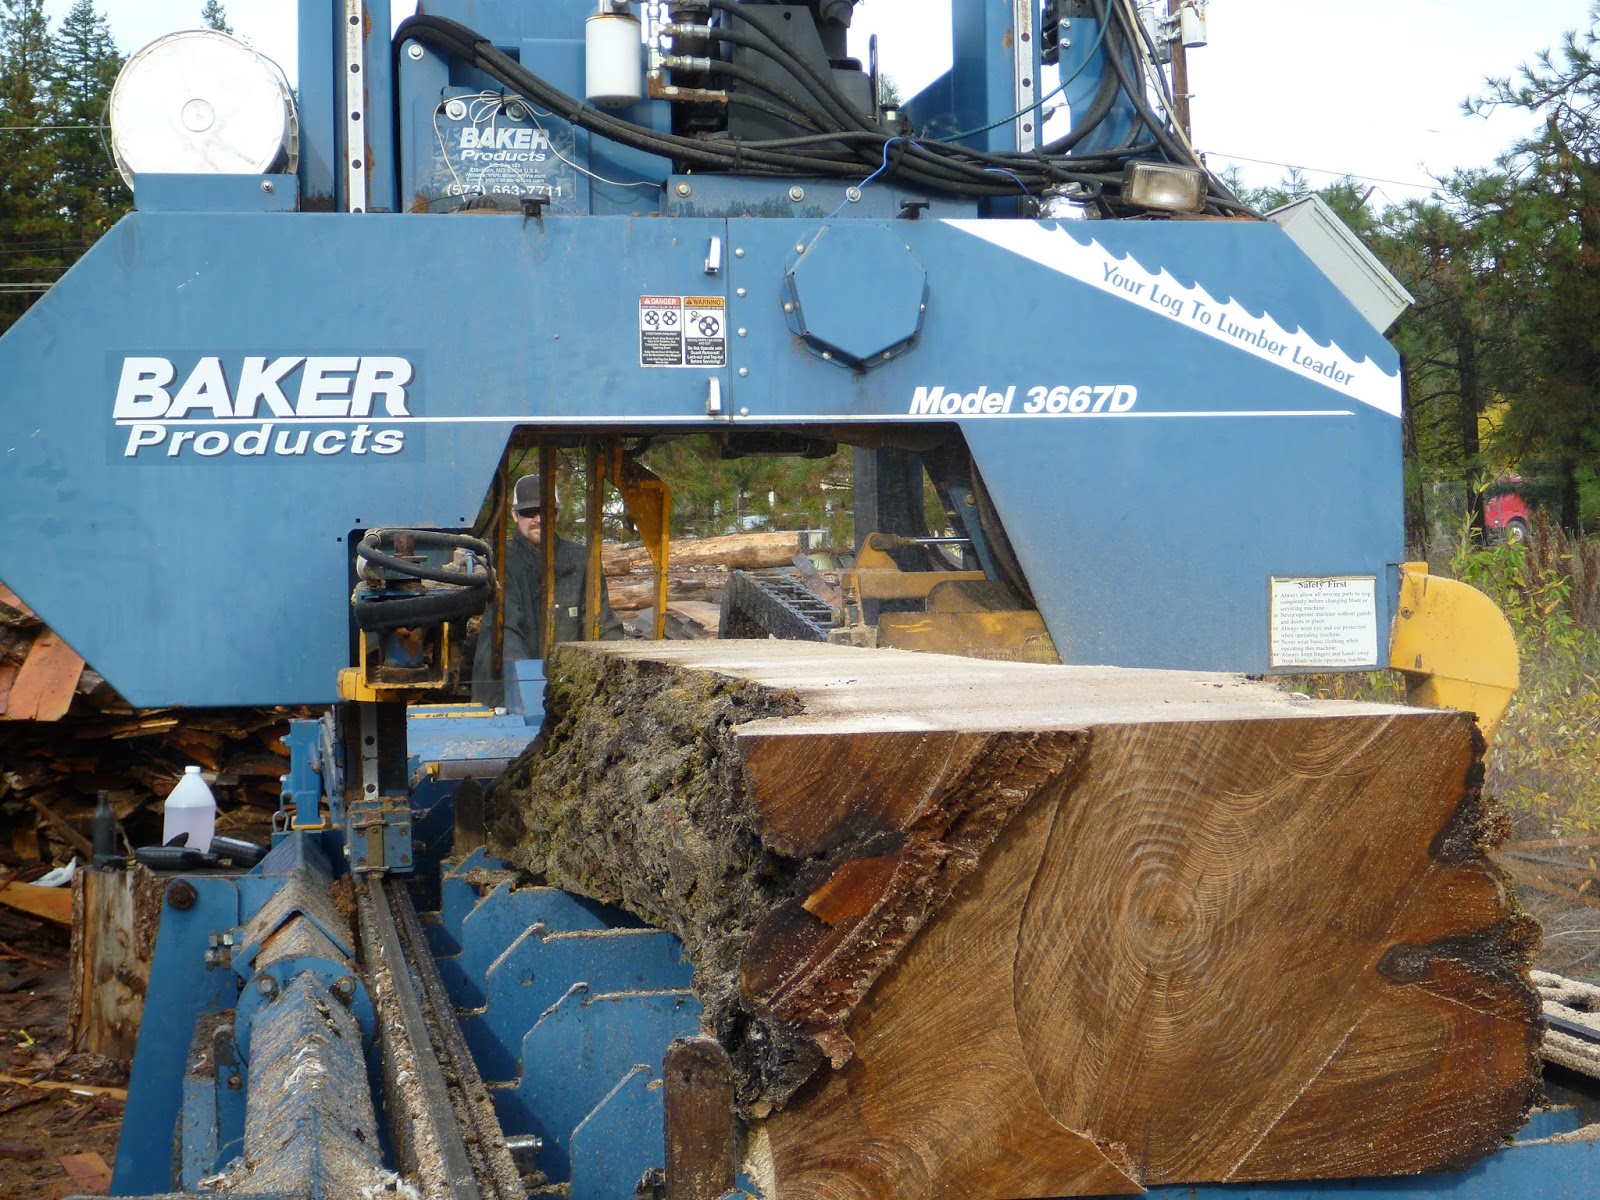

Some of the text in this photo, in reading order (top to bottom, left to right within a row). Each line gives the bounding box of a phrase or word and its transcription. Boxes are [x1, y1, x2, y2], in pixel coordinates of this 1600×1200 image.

[460, 128, 550, 149] BAKER
[460, 150, 546, 162] Products
[492, 185, 562, 196] 663-7711
[1102, 262, 1355, 386] Your Log To Lumber Leader
[112, 356, 414, 418] BAKER
[908, 385, 1138, 414] Model 3667D
[124, 424, 404, 457] Products
